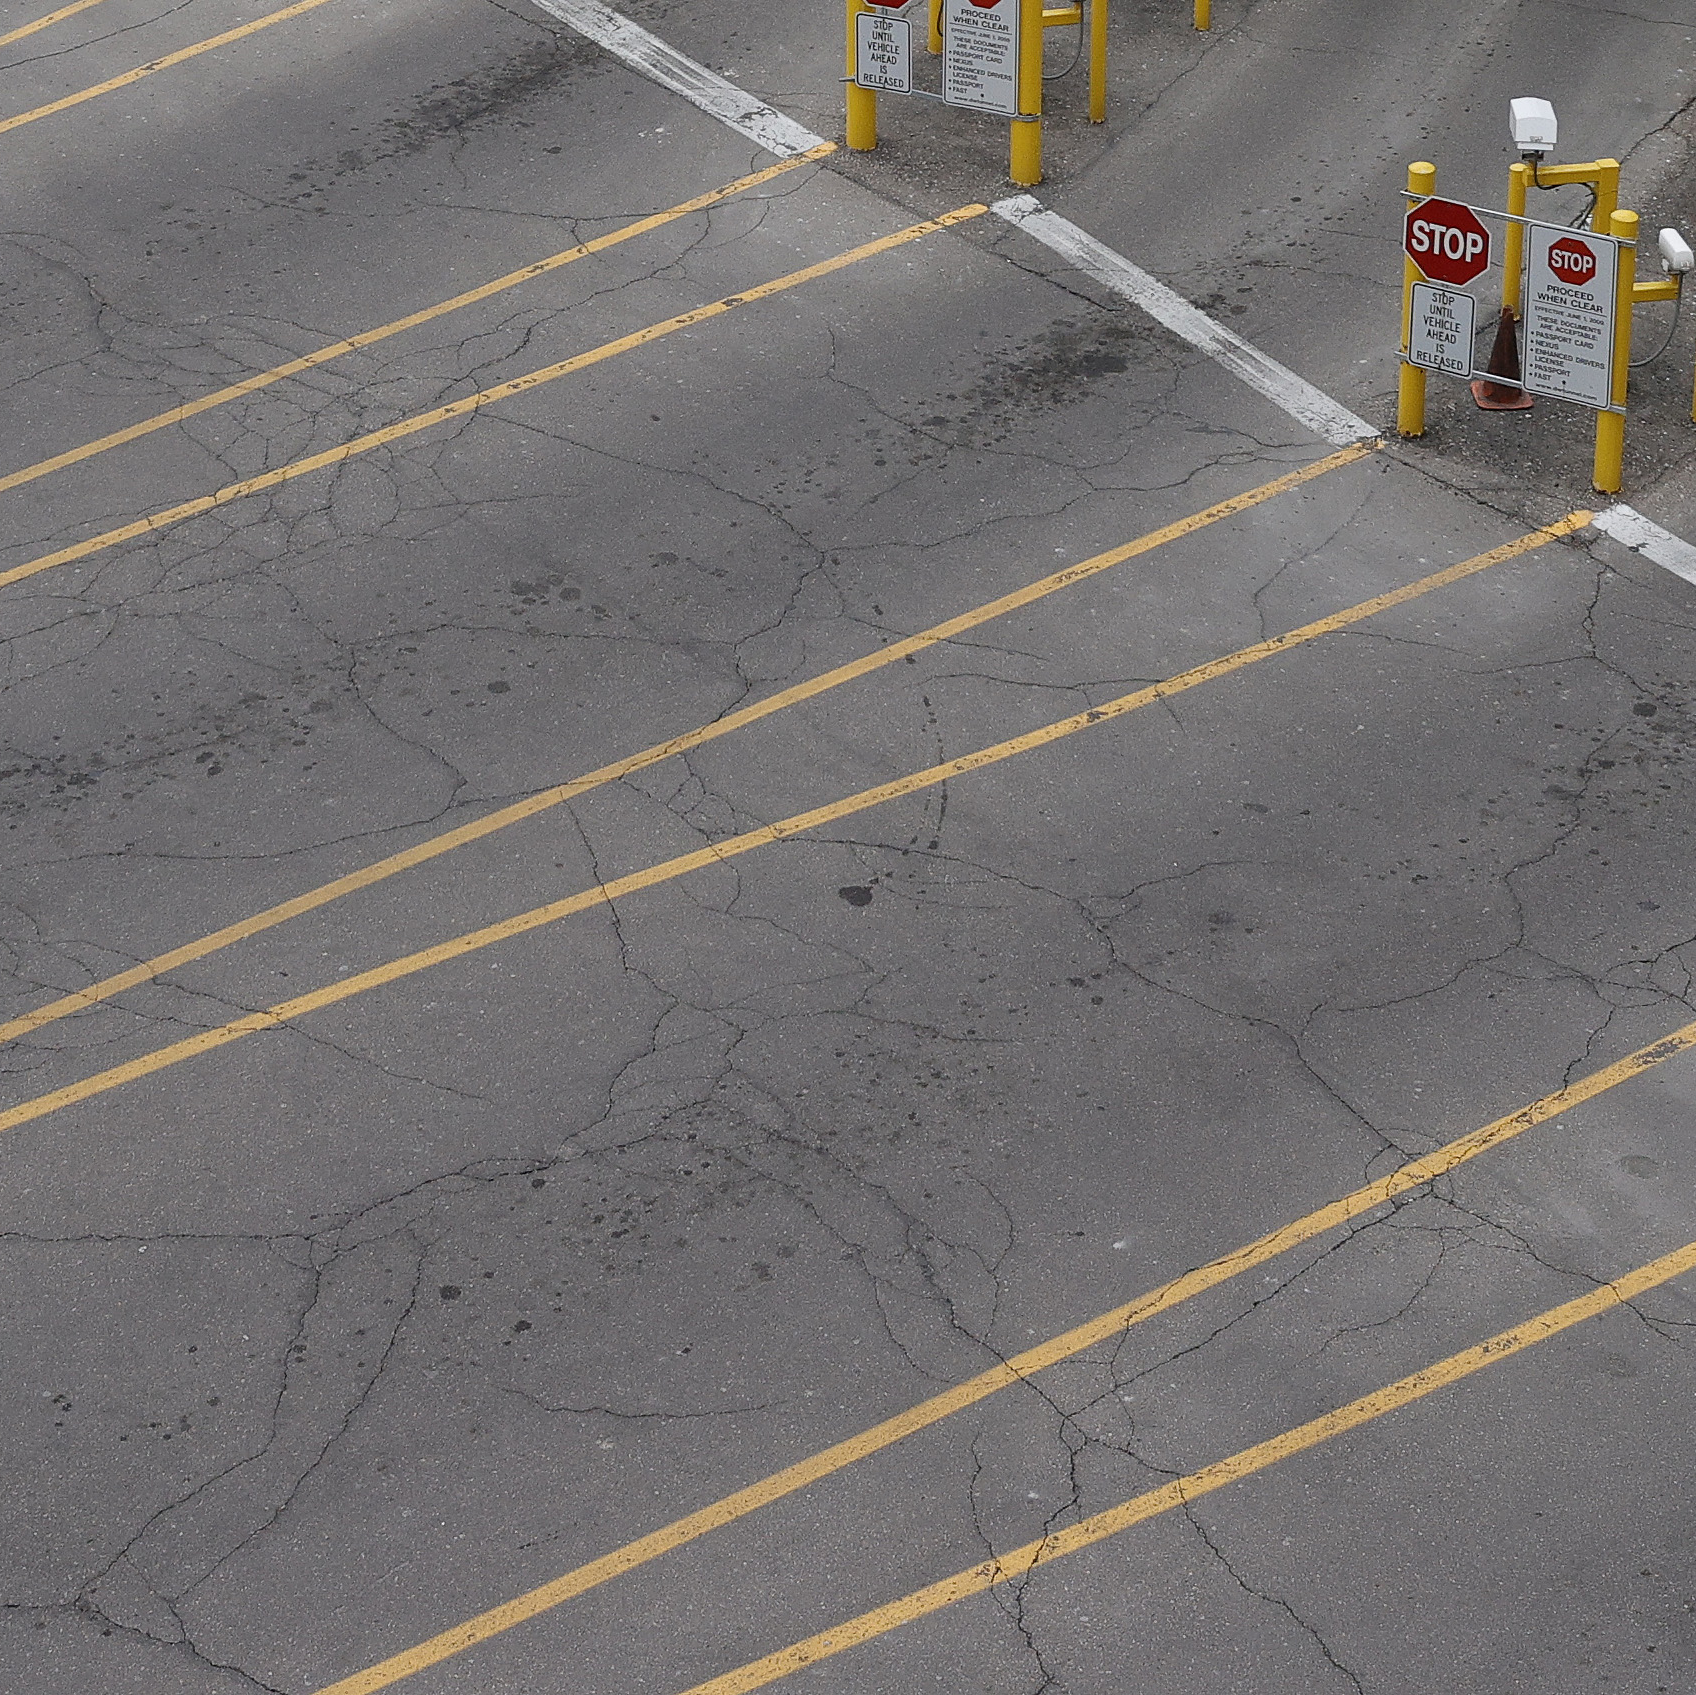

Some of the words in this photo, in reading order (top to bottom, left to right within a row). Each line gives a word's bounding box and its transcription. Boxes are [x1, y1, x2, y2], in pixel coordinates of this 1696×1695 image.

[961, 9, 1001, 22] PROCEED
[873, 19, 893, 30] STOP
[953, 15, 979, 27] WHEN
[982, 21, 1009, 32] CLEAR
[872, 31, 894, 43] UNTIL
[868, 41, 900, 55] VEHICLE
[871, 53, 897, 64] AHEAD
[880, 65, 887, 74] IS
[863, 73, 904, 88] RELEASED
[1411, 220, 1483, 263] STOP
[1551, 249, 1593, 274] STOP
[1432, 292, 1455, 305] STOP
[1547, 284, 1594, 302] PROCEED
[1537, 292, 1567, 306] WHEN
[1571, 299, 1603, 314] CLEAR
[1430, 305, 1455, 319] UNTIL
[1423, 315, 1461, 333] VEHICLE
[1426, 329, 1456, 344] AHEAD
[1536, 331, 1572, 345] PASSPORT
[1575, 339, 1594, 349] CARD
[1436, 343, 1445, 353] IS
[1535, 348, 1572, 362] ENHANCED
[1416, 351, 1463, 371] RELEASED
[1535, 356, 1564, 368] LICENSE
[1534, 364, 1570, 377] PASSPORT
[1534, 373, 1551, 381] FAST
